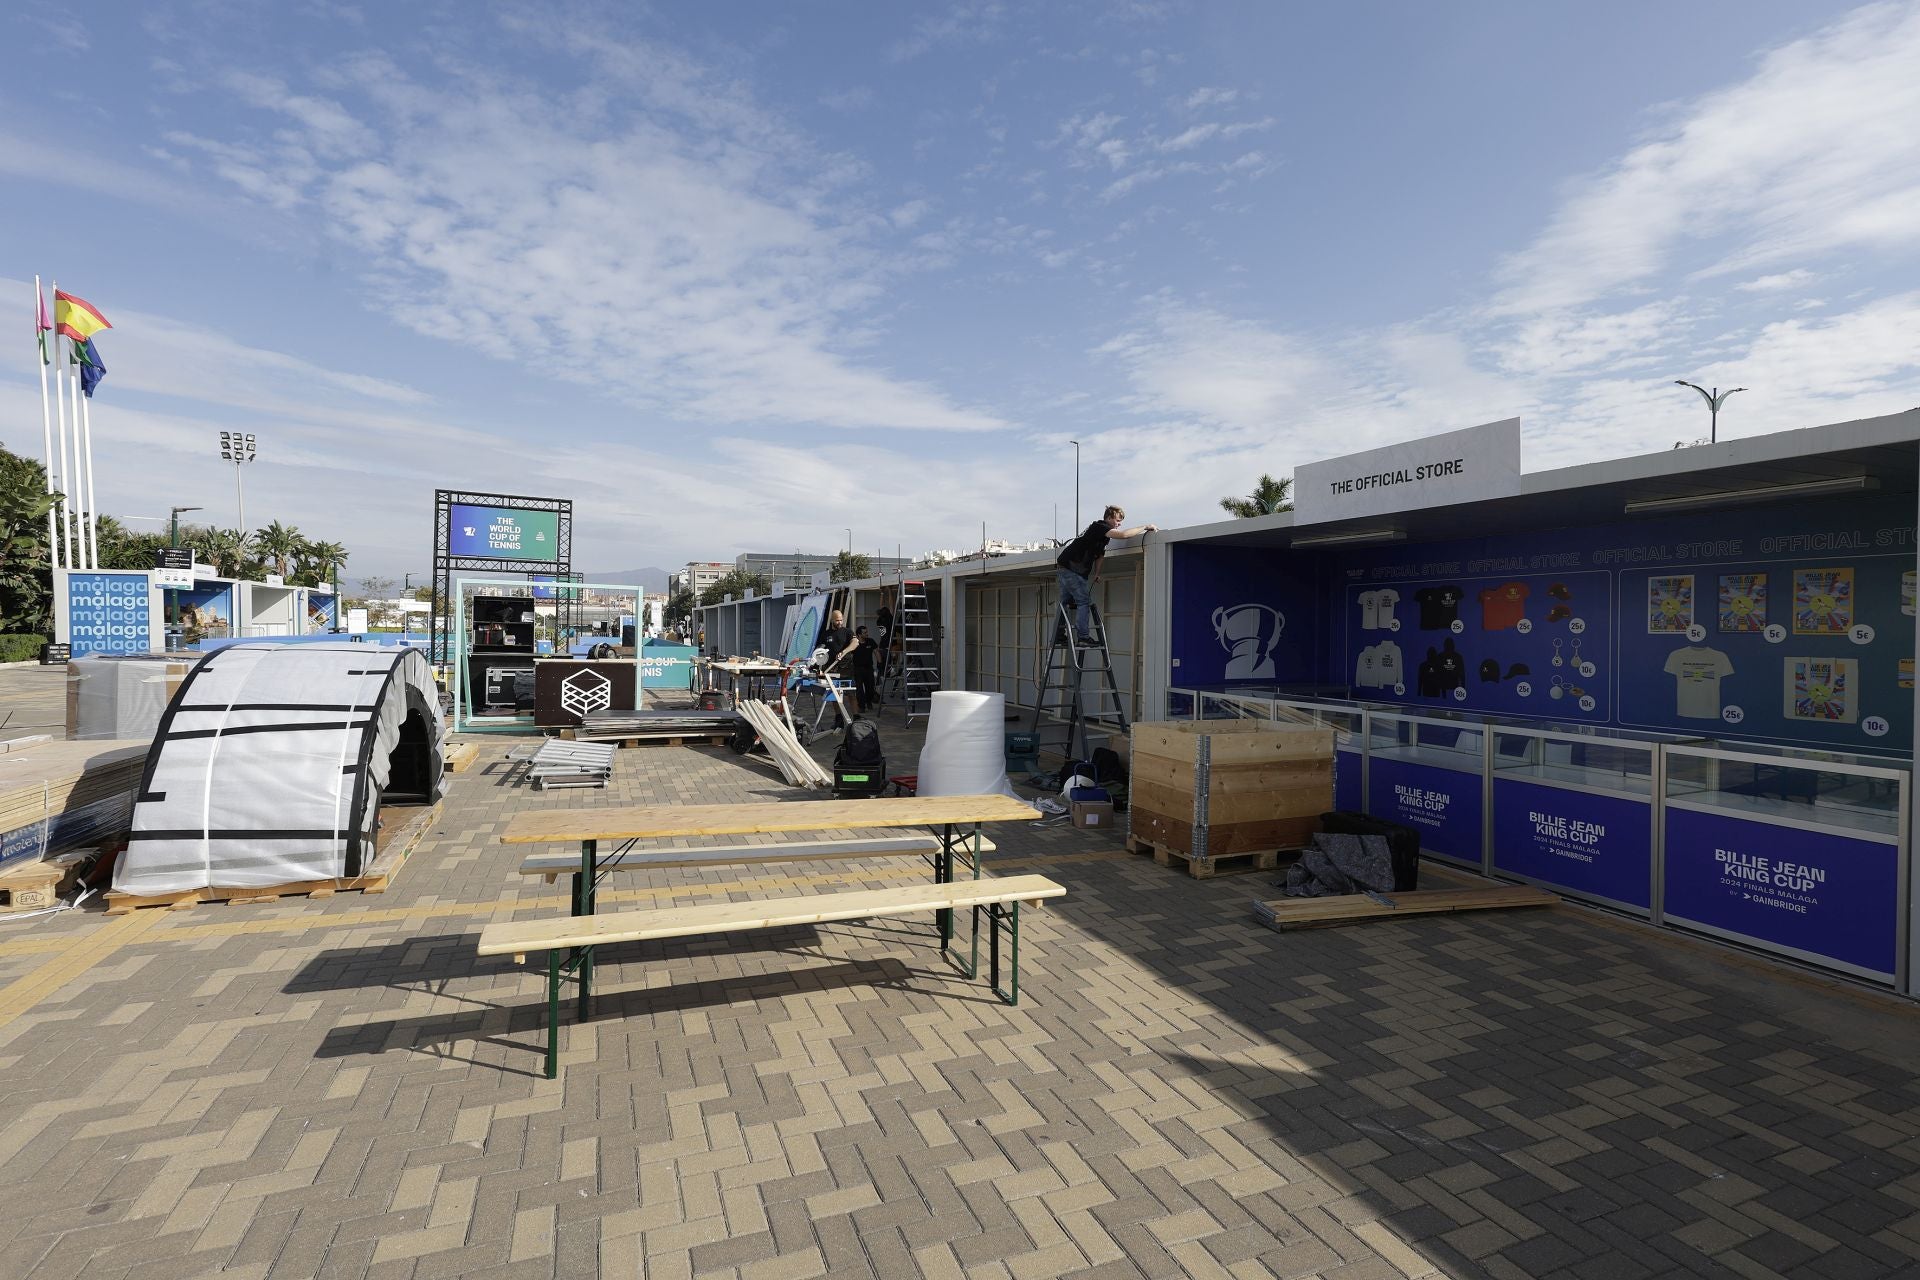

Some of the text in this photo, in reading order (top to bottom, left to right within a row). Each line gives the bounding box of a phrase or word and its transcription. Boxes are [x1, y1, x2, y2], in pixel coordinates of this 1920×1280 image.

[1331, 459, 1464, 495] THE OFFICIAL STORE
[489, 525, 521, 534] WORLD
[496, 517, 514, 526] THE
[489, 532, 521, 542] CUP OF
[489, 540, 521, 550] TENNIS
[1468, 556, 1528, 572] OFFICIAL
[1530, 552, 1581, 569] STORE
[1593, 544, 1672, 563] OFFICIAL
[1675, 539, 1744, 560] STORE
[1760, 530, 1870, 553] OFFICIAL
[1691, 630, 1701, 638] 5€
[1769, 630, 1780, 638] 5€
[1856, 630, 1869, 639] 5€
[1725, 711, 1741, 719] 25€
[1868, 720, 1884, 731] 10€
[1395, 784, 1450, 804] BILLIE JEAN
[1400, 794, 1445, 811] KING CUP
[1529, 811, 1605, 837] BILLIE JEAN
[1536, 822, 1599, 845] KING CUP
[1533, 835, 1601, 856] 2024 FINALS MALAGA
[1715, 848, 1825, 882] BILLIE JEAN
[1724, 863, 1815, 892] KING CUP
[1720, 877, 1818, 905] 2024 FINALS MALAGA
[1752, 894, 1807, 914] GAINBRIDGE
